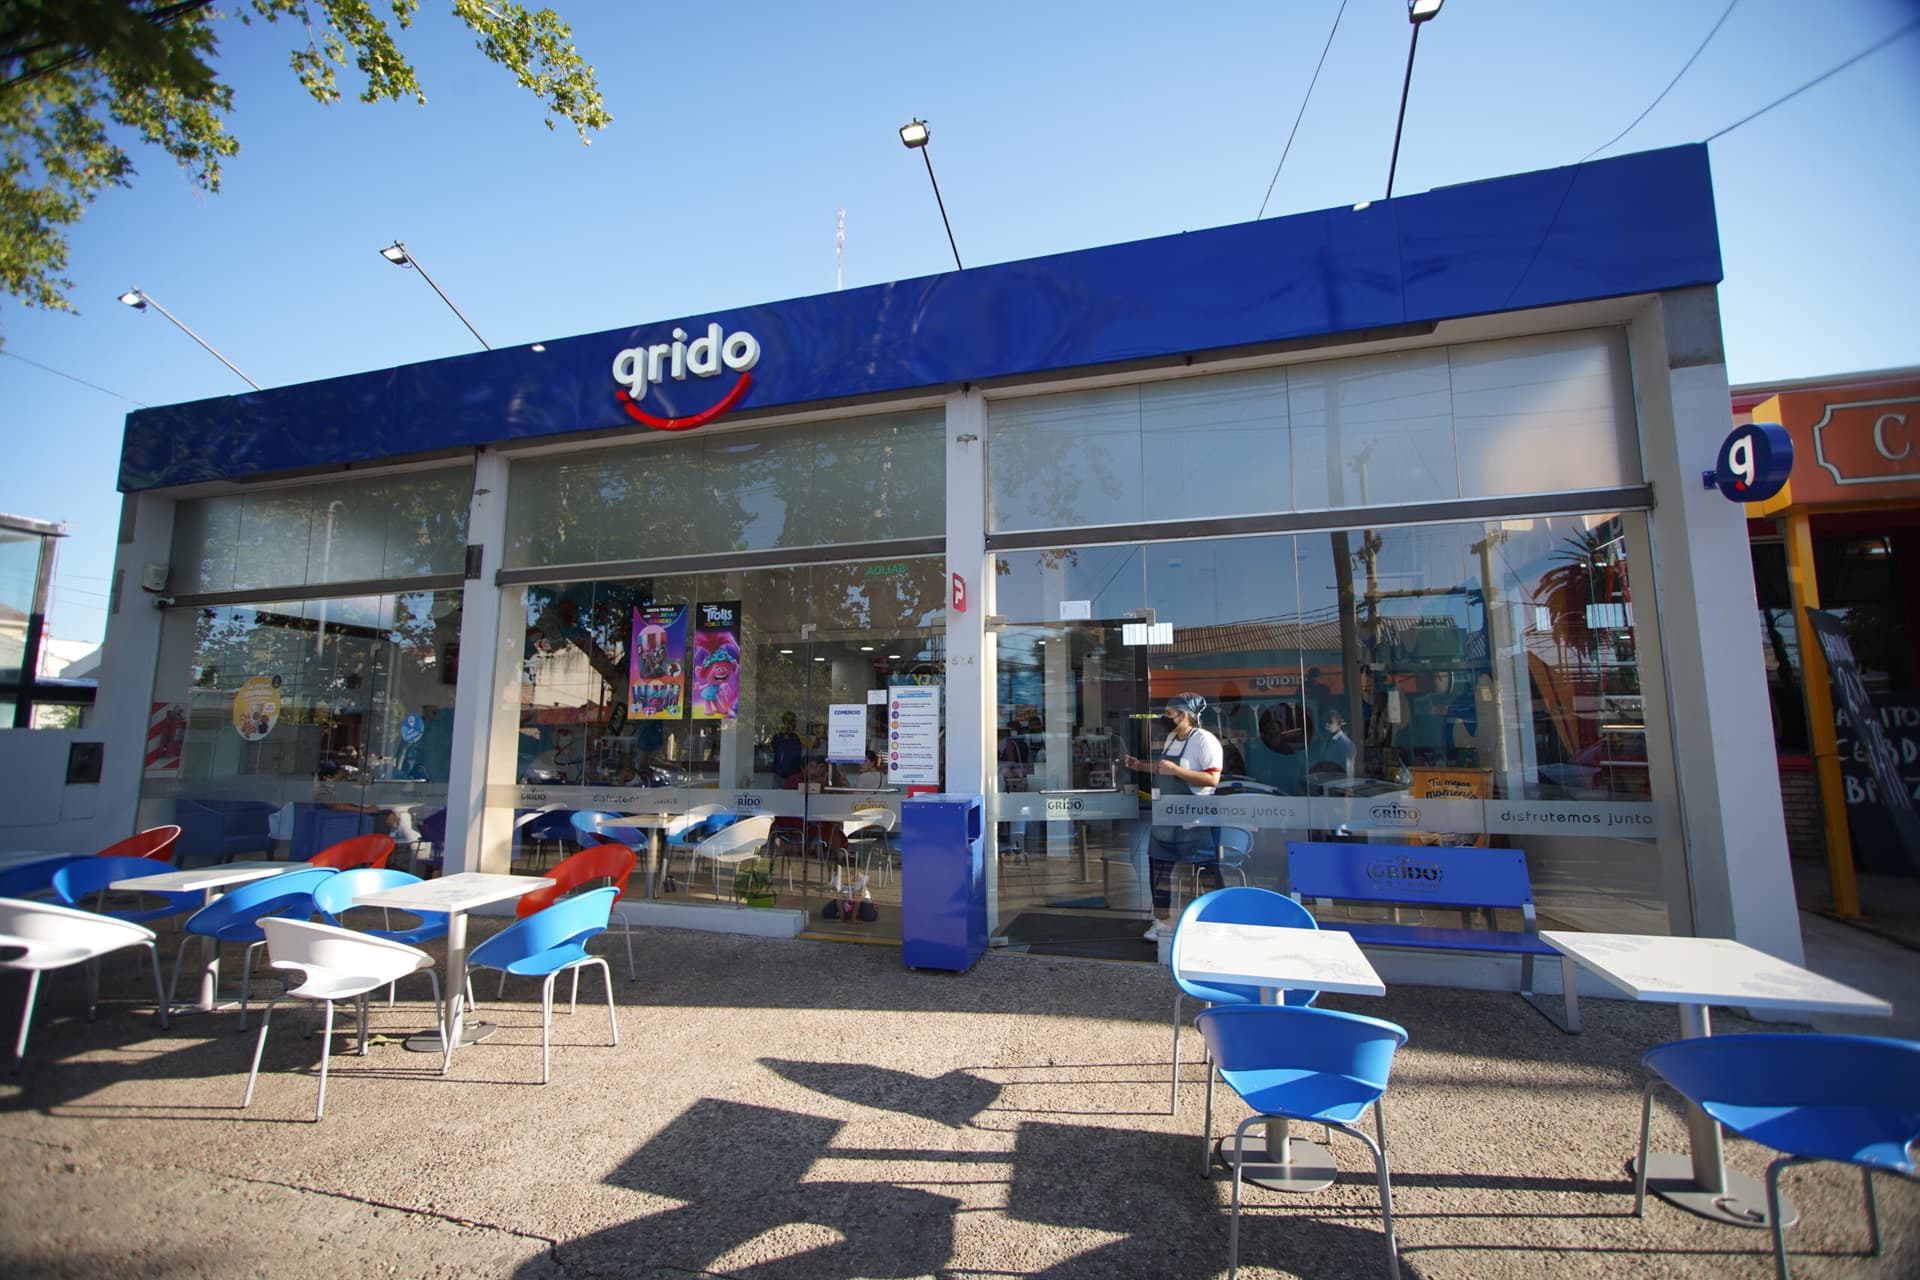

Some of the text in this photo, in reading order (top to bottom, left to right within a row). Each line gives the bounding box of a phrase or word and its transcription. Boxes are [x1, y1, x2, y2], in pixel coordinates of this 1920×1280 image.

[612, 322, 760, 400] grido
[1874, 414, 1910, 460] C
[737, 794, 761, 806] RIDO
[1166, 804, 1247, 816] disfrutemos
[1372, 804, 1418, 819] GRIDO
[1501, 810, 1653, 825] disfrutemos junto
